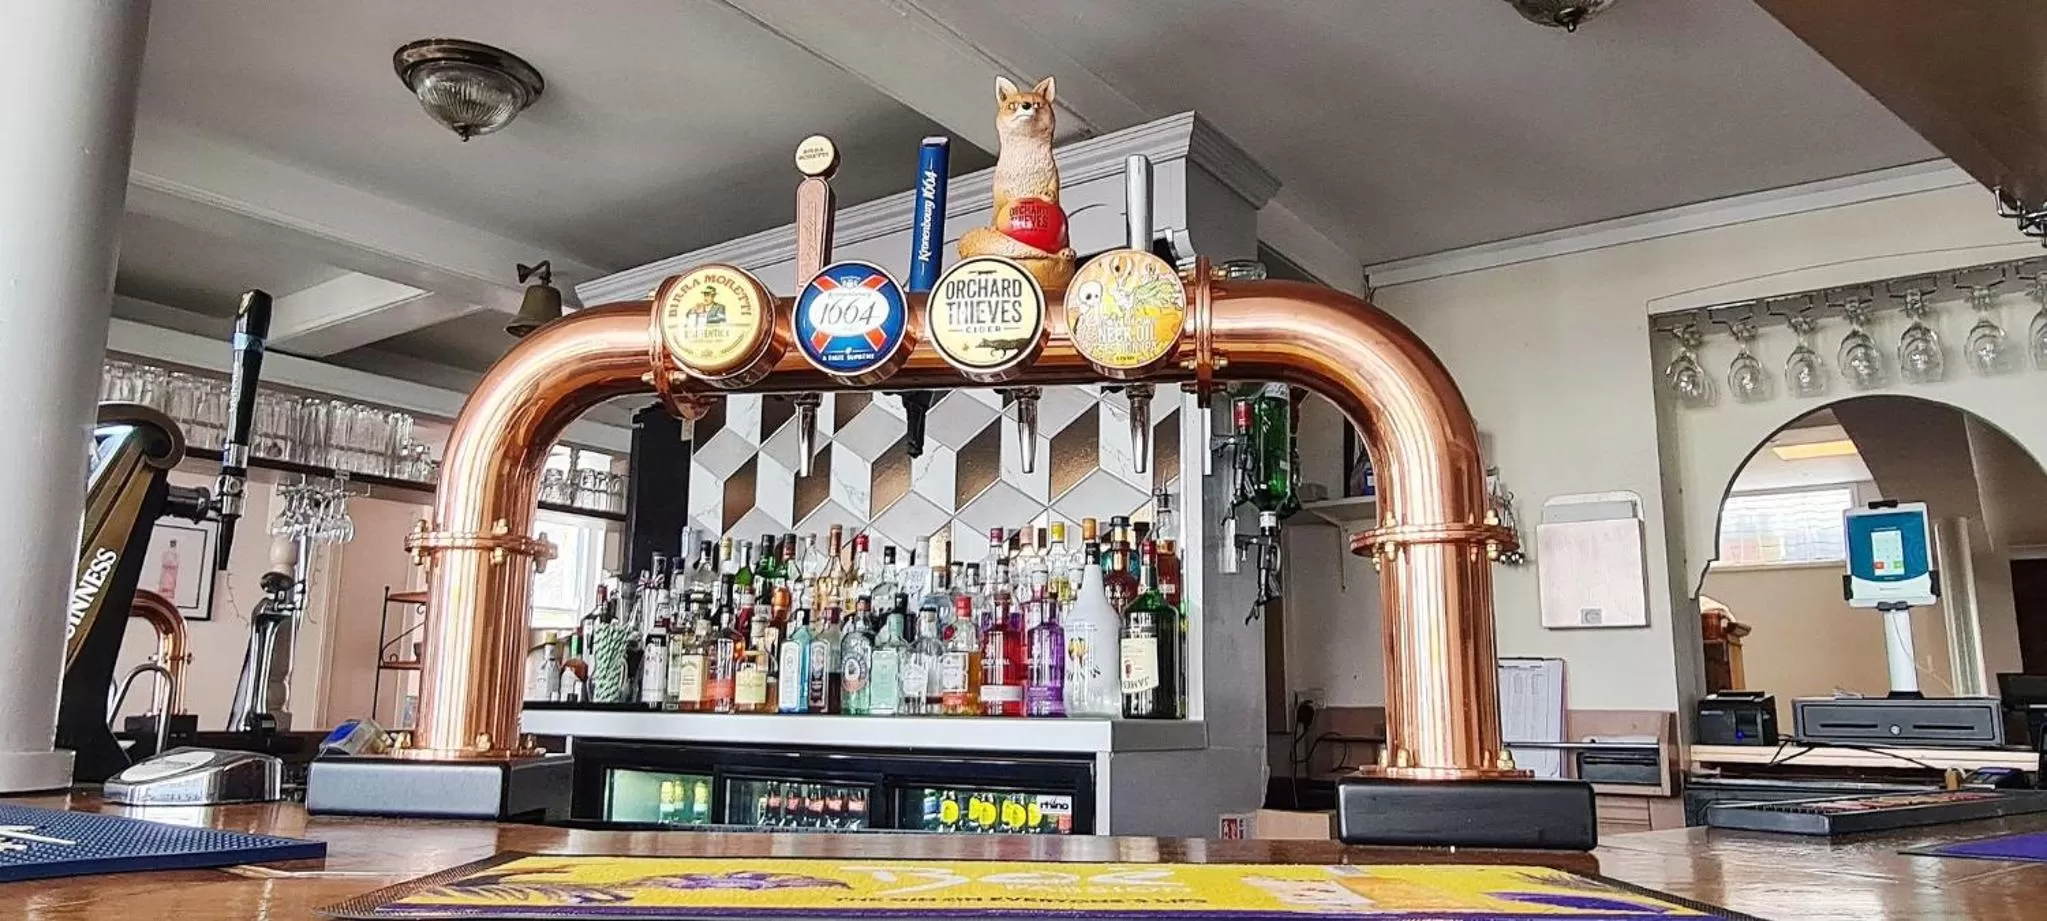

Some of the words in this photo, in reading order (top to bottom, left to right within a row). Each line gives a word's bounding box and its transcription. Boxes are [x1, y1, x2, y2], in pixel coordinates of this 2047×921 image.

[922, 169, 938, 200] 1664
[1010, 205, 1049, 217] ORCHARD
[668, 278, 701, 317] BIRRA
[704, 274, 752, 316] MORETTI
[945, 278, 1022, 300] ORCHARD
[820, 298, 880, 326] 1664
[945, 299, 1022, 325] THIEVES
[965, 325, 1001, 333] CIDER
[1097, 325, 1132, 343] NECK
[1135, 323, 1157, 342] OIL
